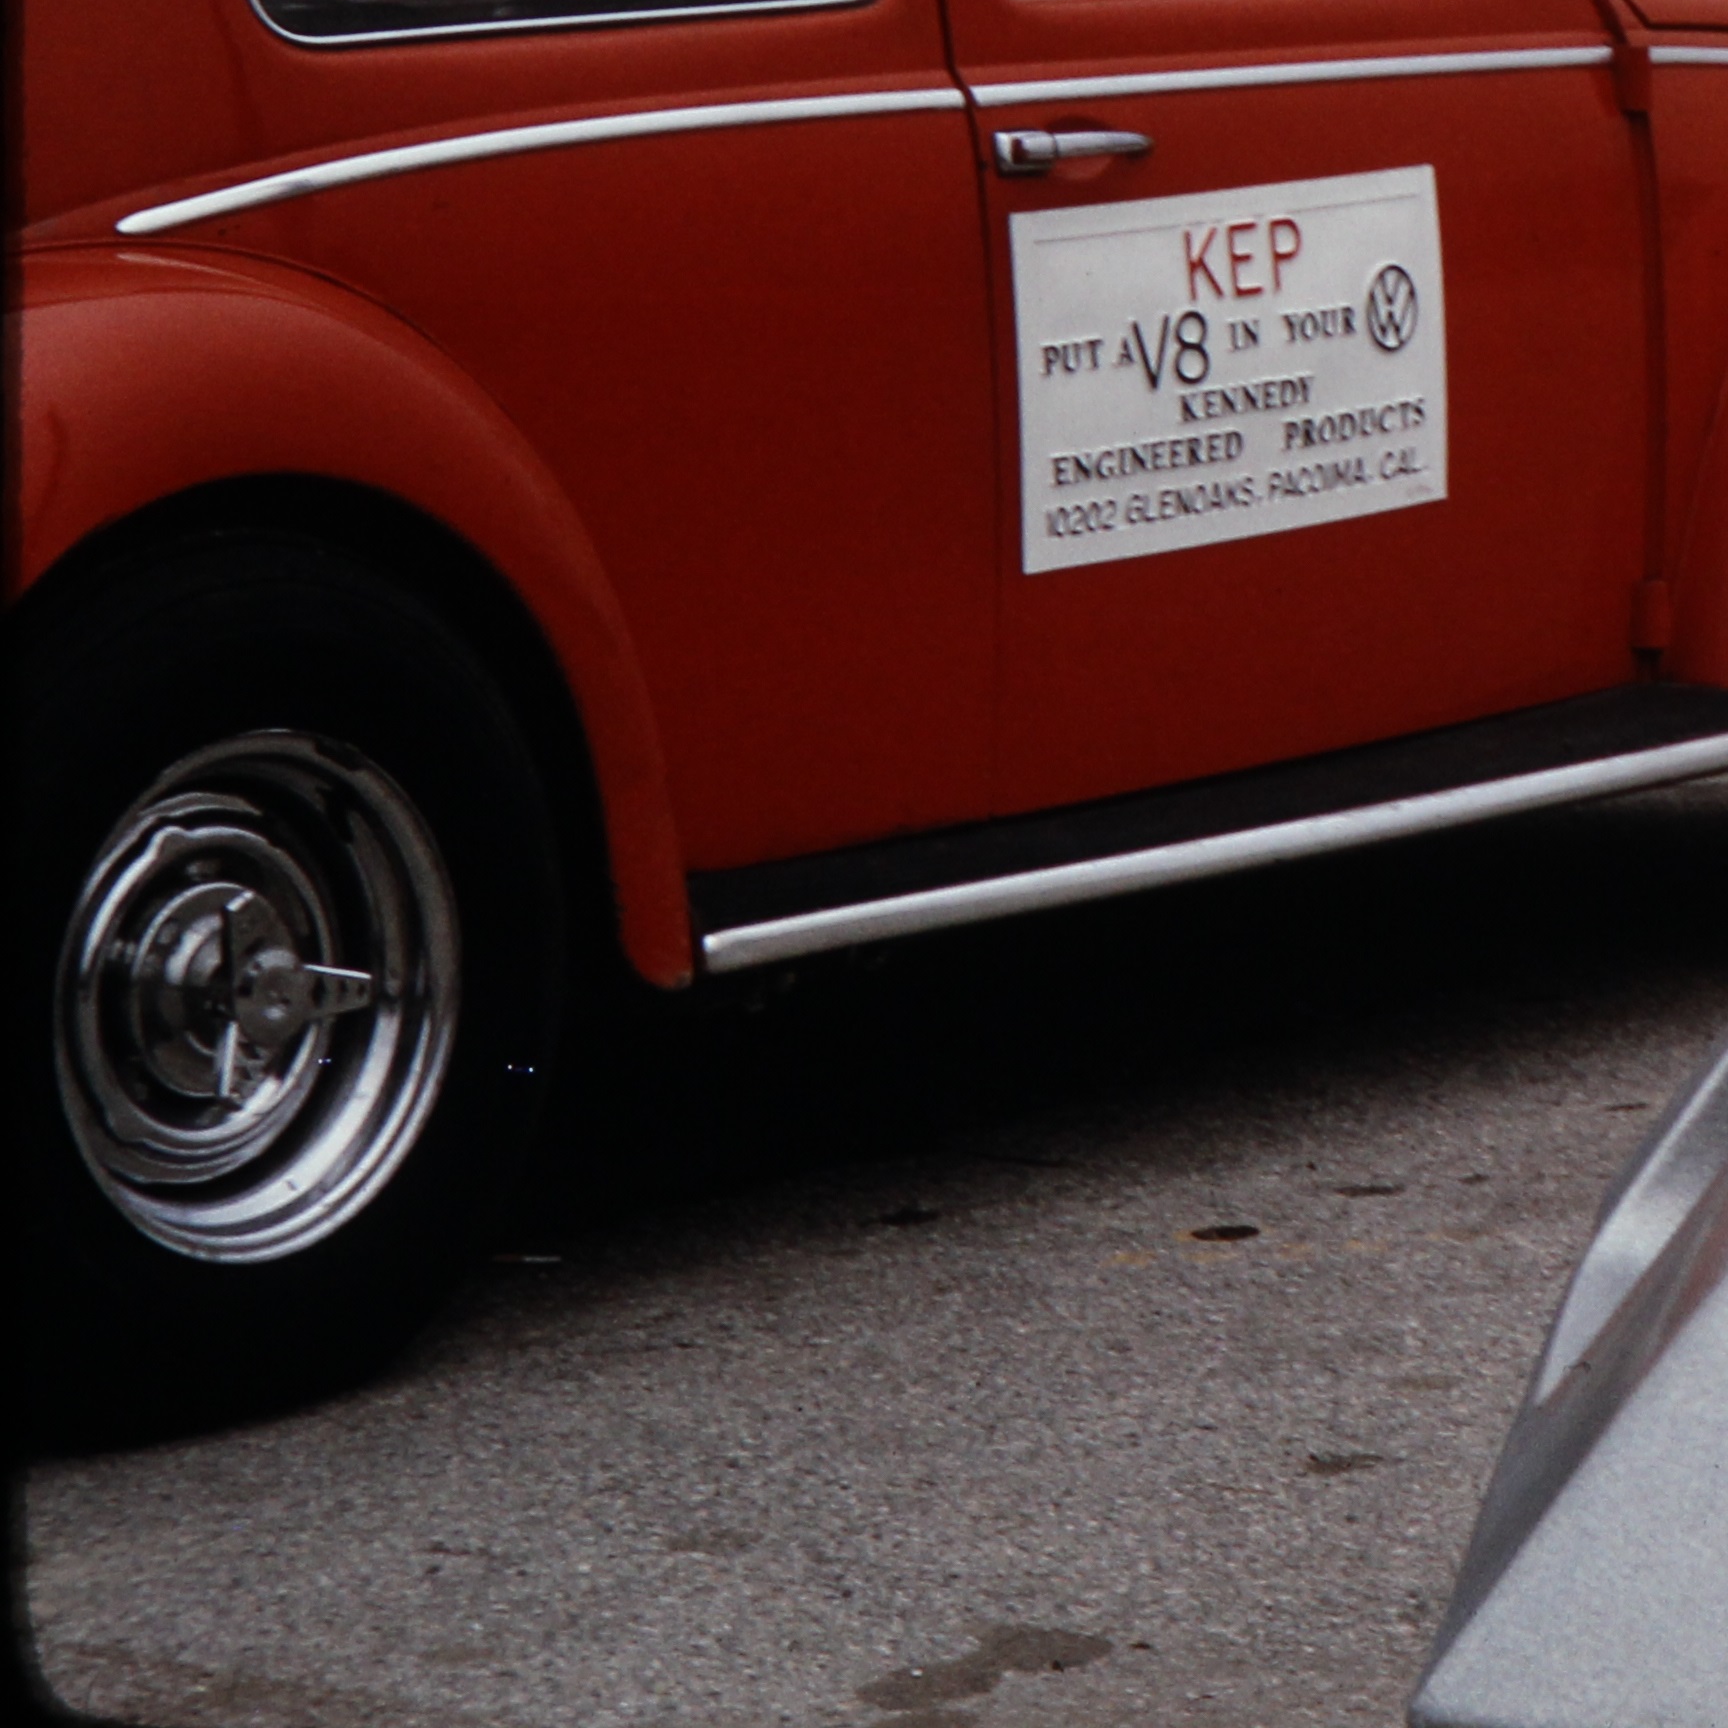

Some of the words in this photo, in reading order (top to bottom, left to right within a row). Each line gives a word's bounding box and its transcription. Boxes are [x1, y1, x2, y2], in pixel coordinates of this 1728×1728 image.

[1183, 217, 1302, 302] KEP
[1041, 340, 1103, 376] PUT
[1114, 339, 1135, 367] A
[1132, 311, 1210, 390] V8
[1228, 319, 1261, 352] IN
[1283, 306, 1357, 346] YOUR
[1180, 376, 1314, 423] KENNEDY
[1049, 430, 1245, 488] ENGINEERED
[1284, 398, 1426, 451] PRODUCTS
[1045, 501, 1116, 539] 10202
